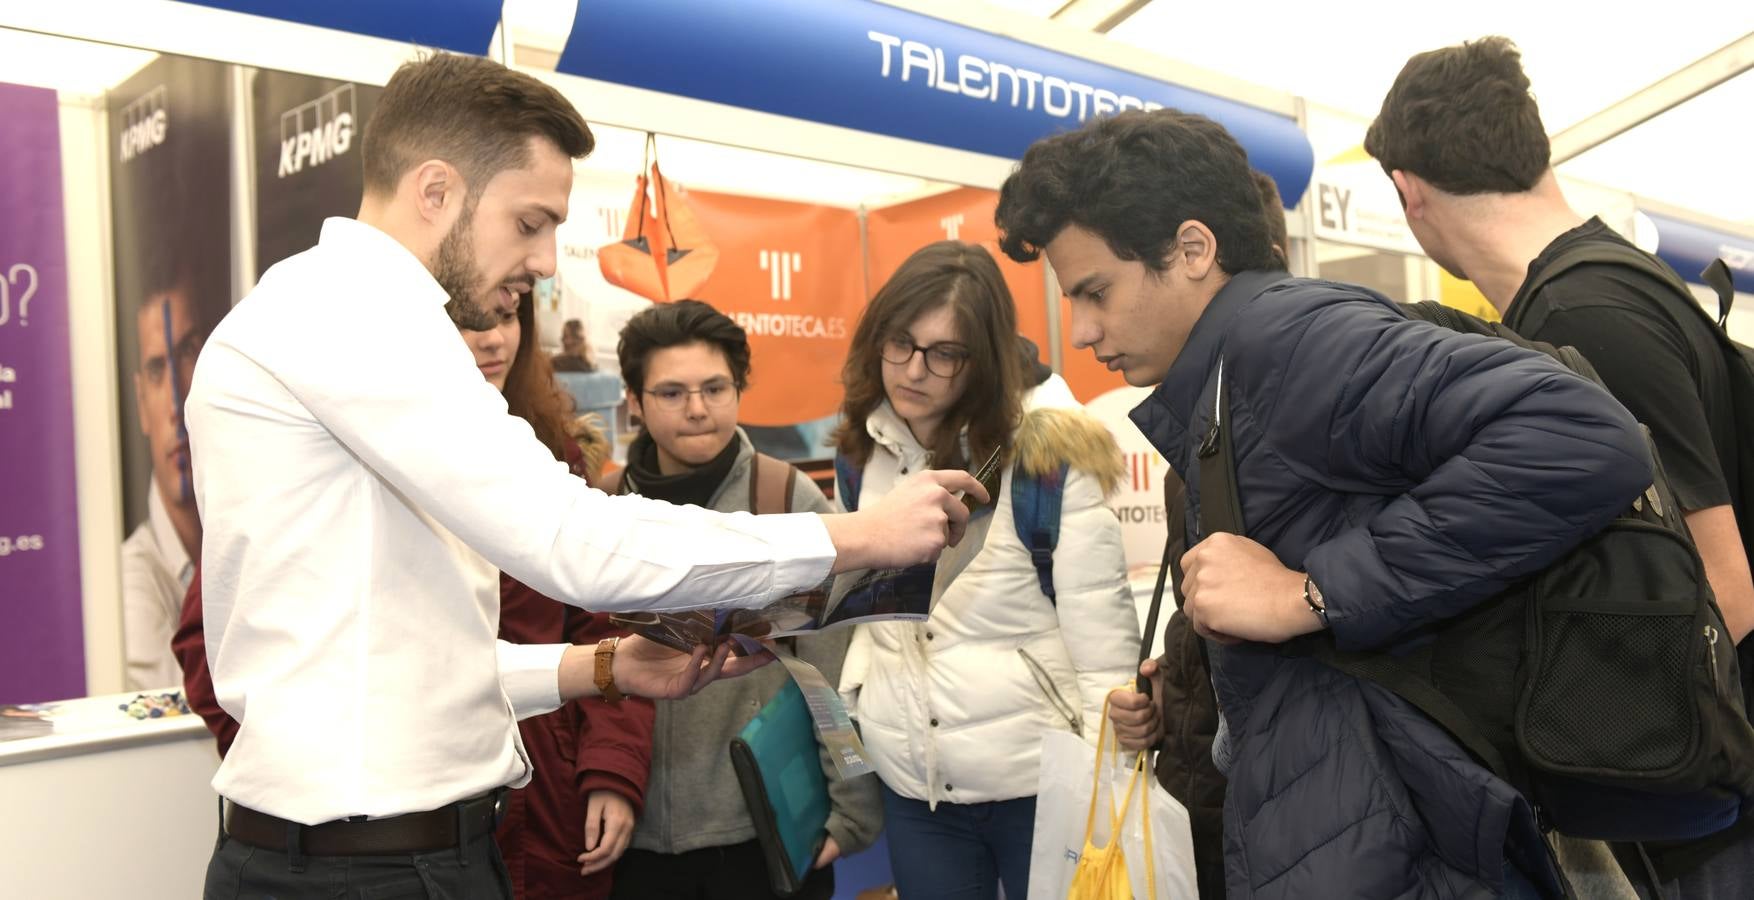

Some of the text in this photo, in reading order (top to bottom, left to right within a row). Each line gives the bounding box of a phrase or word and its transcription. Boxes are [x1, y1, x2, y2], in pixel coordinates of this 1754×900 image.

[867, 30, 1164, 122] TALENTOTE
[119, 108, 167, 163] KPMG
[278, 112, 354, 179] KPMG
[1319, 183, 1351, 231] EY
